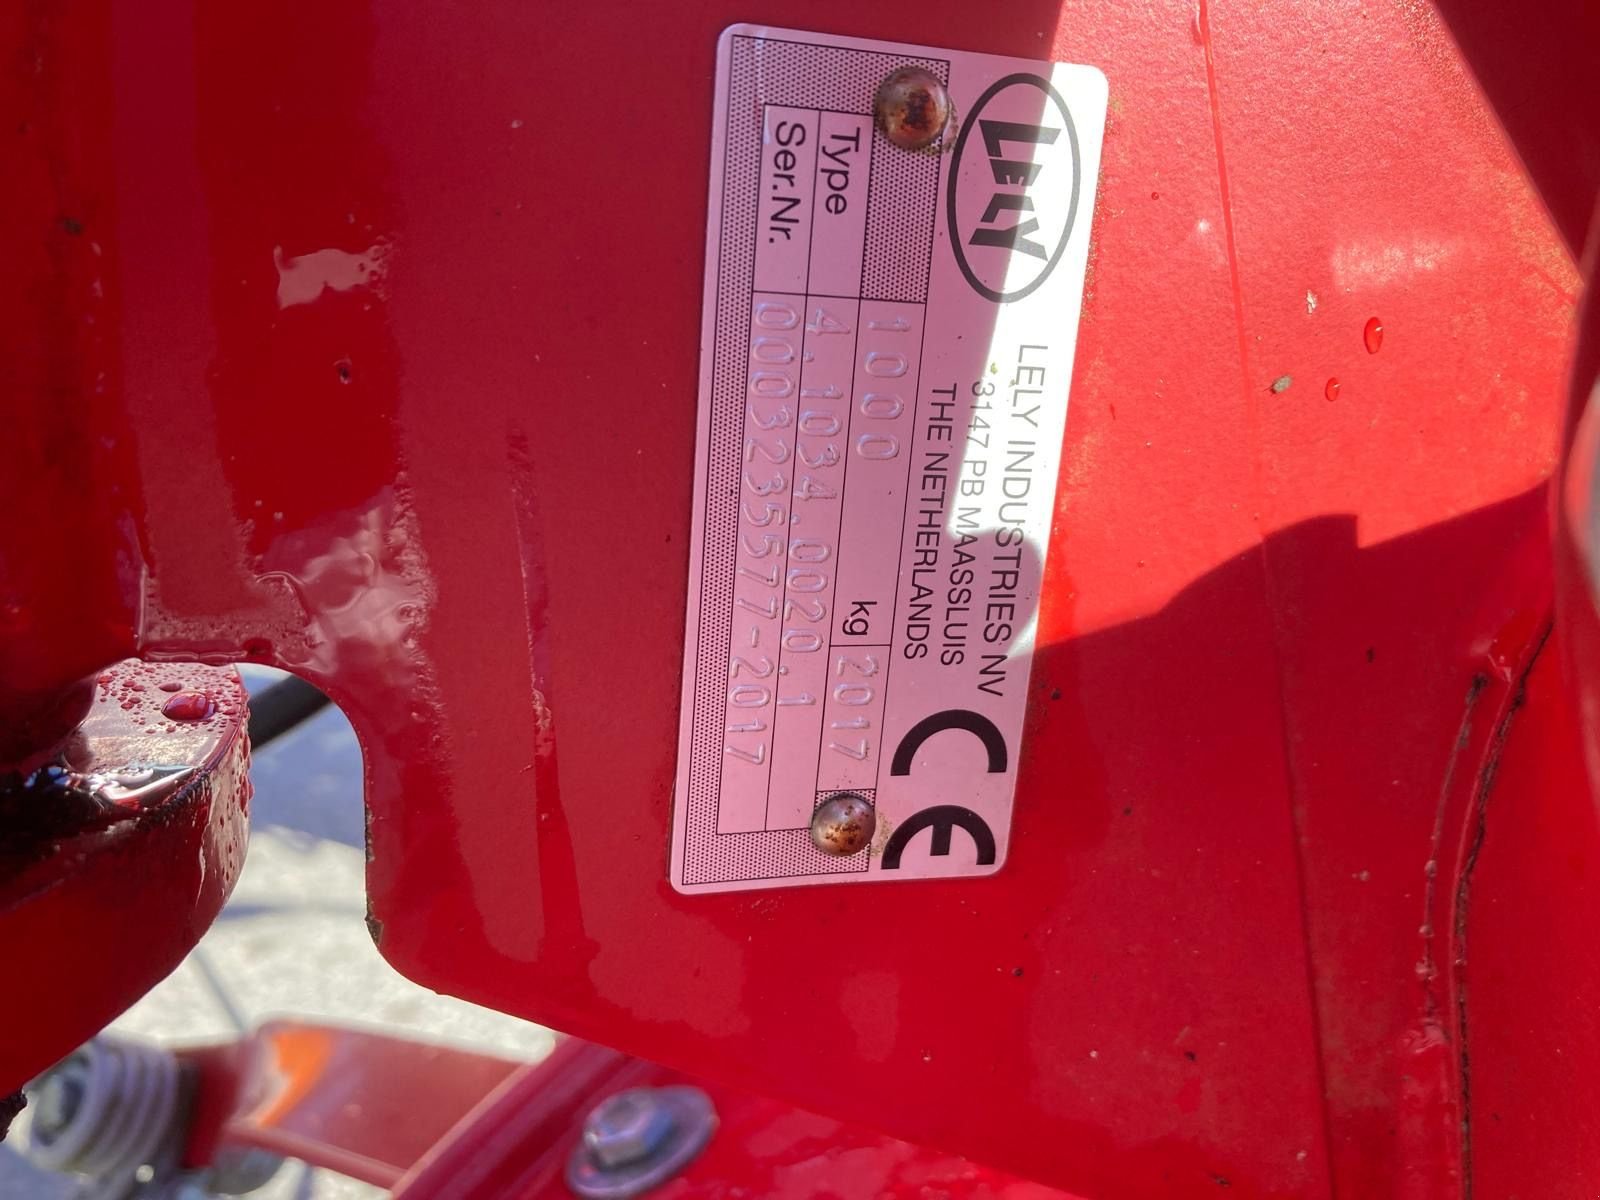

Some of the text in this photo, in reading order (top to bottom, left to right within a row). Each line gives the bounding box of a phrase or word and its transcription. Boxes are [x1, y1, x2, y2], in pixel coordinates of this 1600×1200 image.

[820, 127, 861, 216] Type
[968, 119, 1062, 261] LELY
[829, 316, 912, 762] 1000 kg 2017
[903, 382, 957, 660] THE NETHERLANDS
[940, 380, 995, 666] 3147 PB MAASSLUIS
[976, 344, 1049, 697] LELY INDUSTRIES NV
